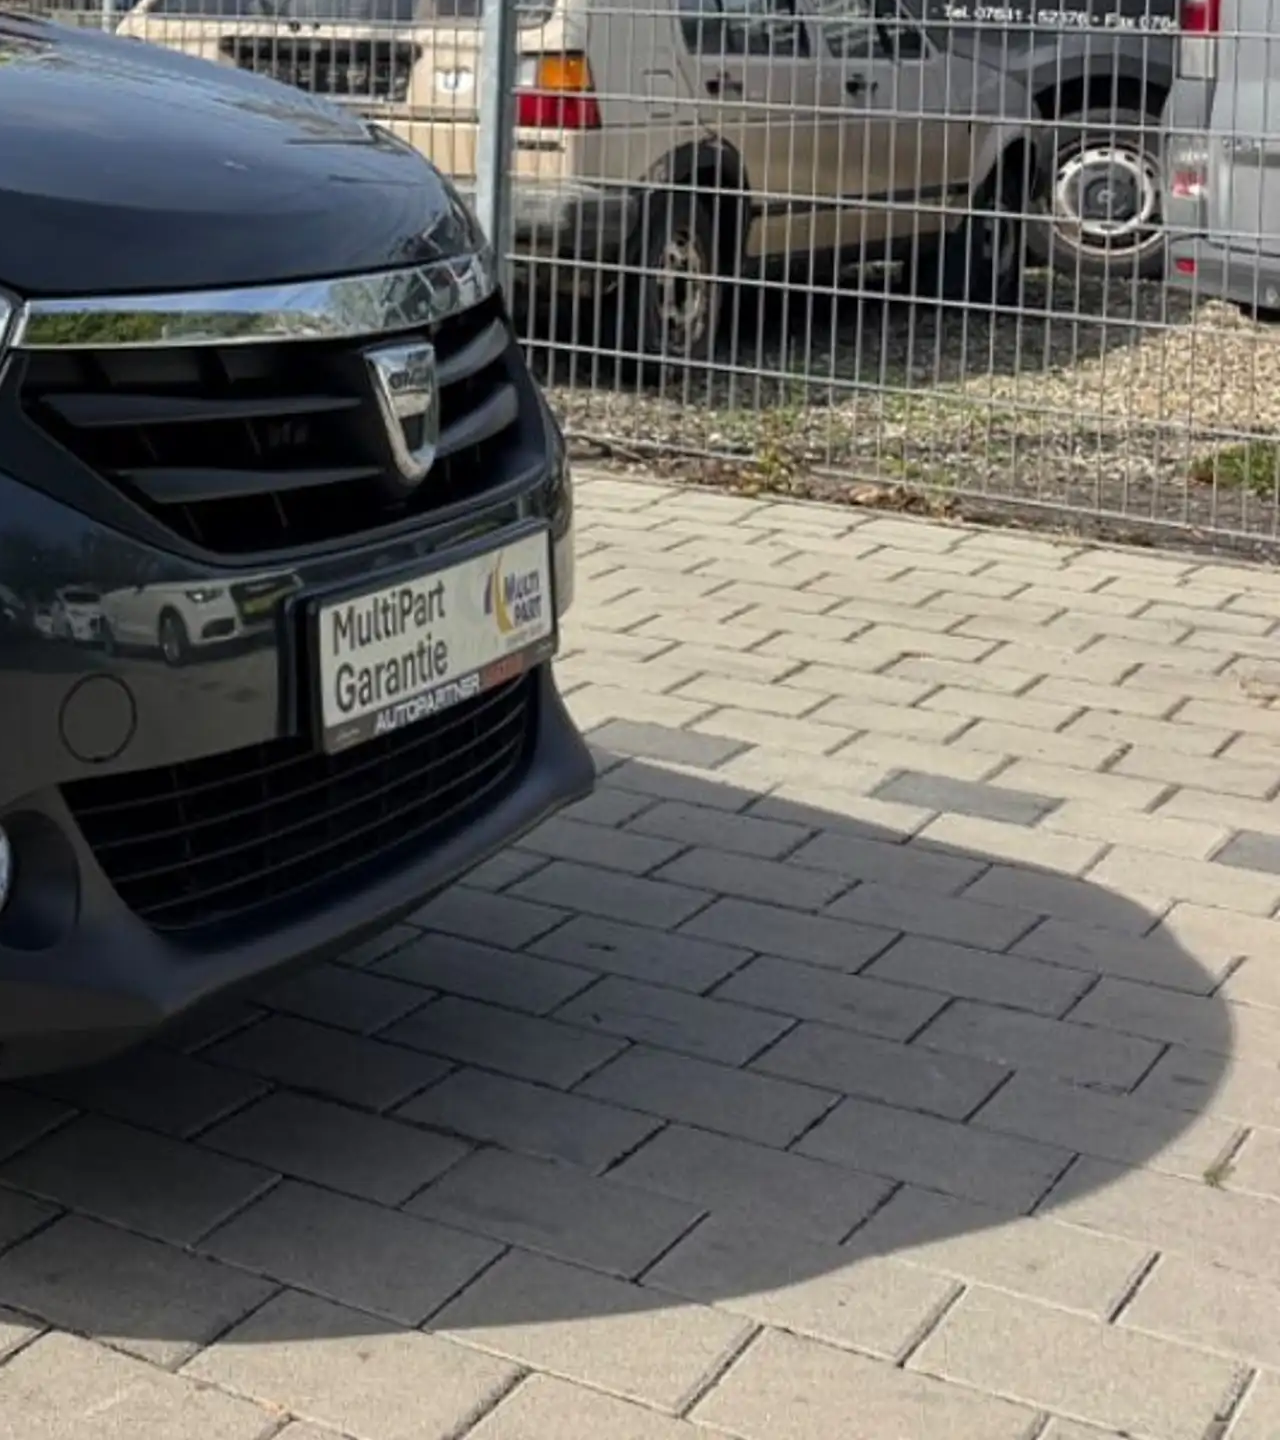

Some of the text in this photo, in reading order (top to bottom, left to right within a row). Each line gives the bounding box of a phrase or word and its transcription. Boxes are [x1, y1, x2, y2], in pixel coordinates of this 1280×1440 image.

[331, 579, 446, 656] MultiPart
[335, 632, 450, 713] Garantie
[374, 673, 482, 735] AUTOPARTNER
